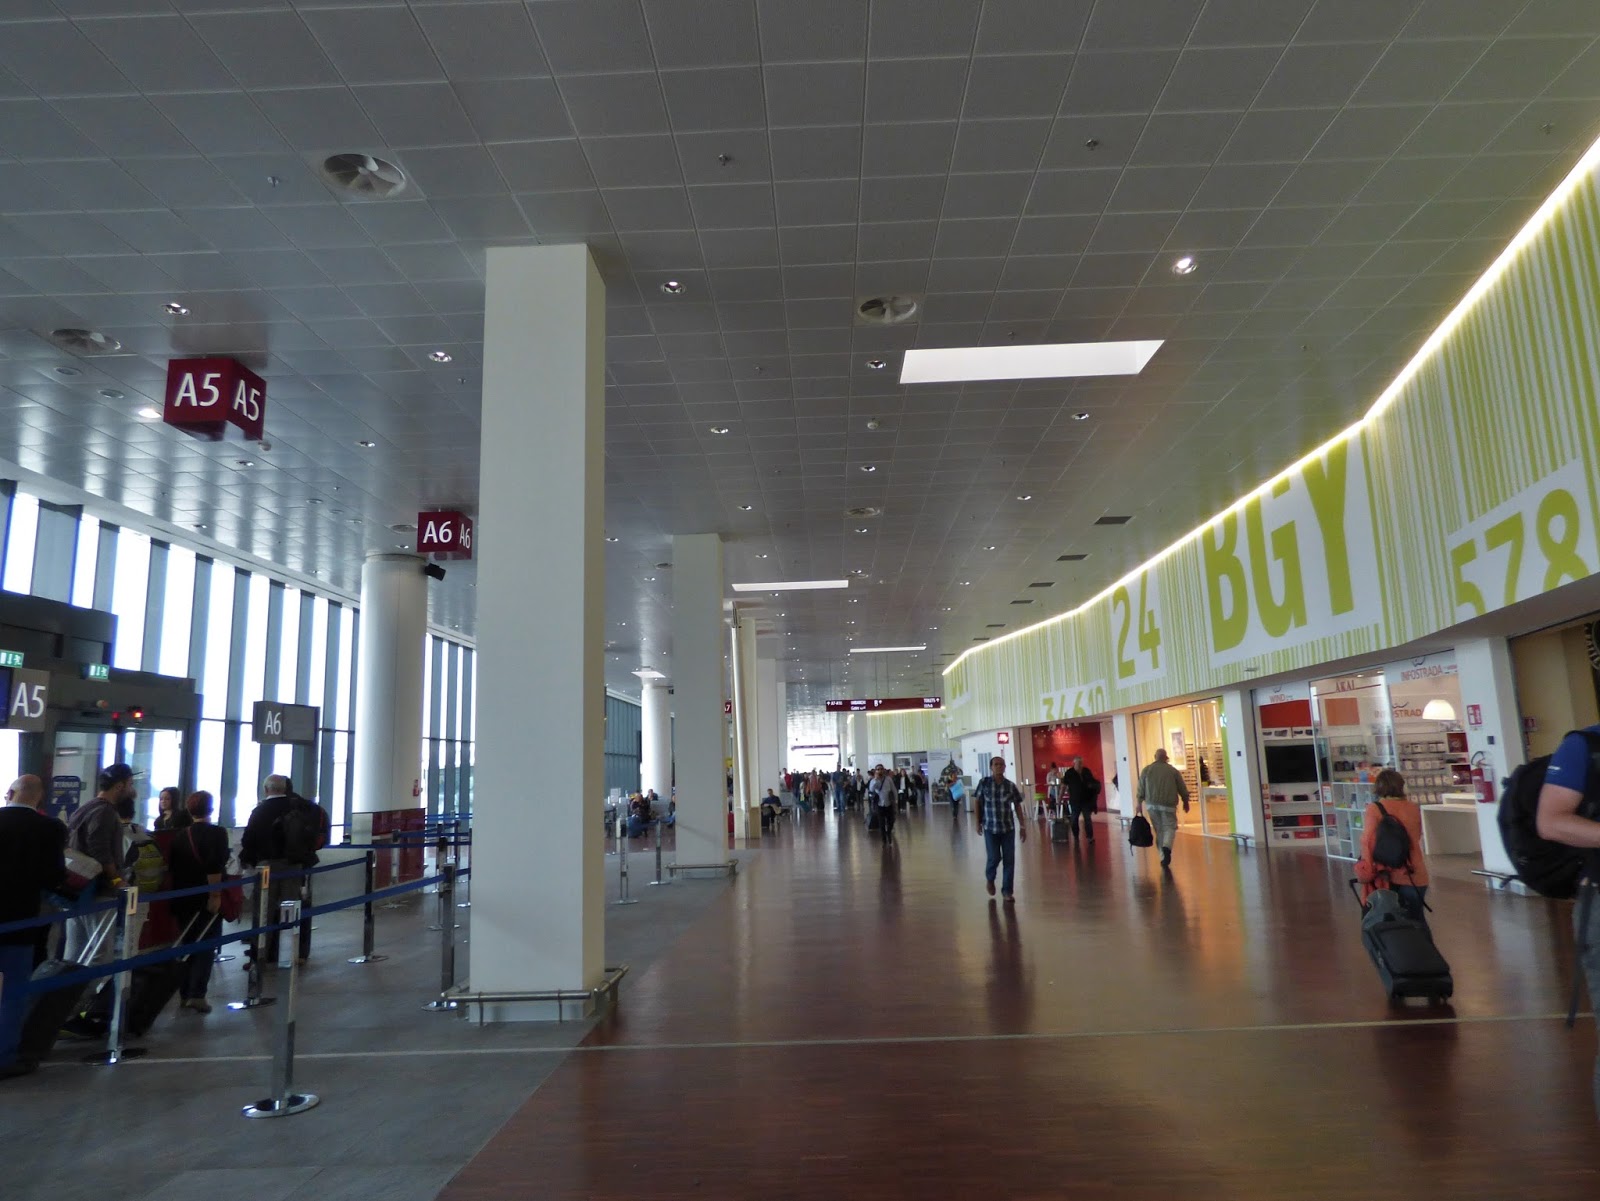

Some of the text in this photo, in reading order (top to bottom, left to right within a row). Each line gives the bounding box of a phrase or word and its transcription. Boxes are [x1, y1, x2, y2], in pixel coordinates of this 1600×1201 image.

[174, 372, 222, 408] A5
[233, 378, 261, 422] A5
[423, 520, 453, 545] A6
[459, 523, 472, 549] A6
[1203, 434, 1355, 653] BGY
[1450, 487, 1590, 619] 578
[1112, 569, 1161, 678] 24
[1335, 680, 1356, 693] AKAI
[1401, 664, 1443, 682] INFOSTRADA
[11, 681, 47, 719] A5
[264, 710, 282, 735] A6
